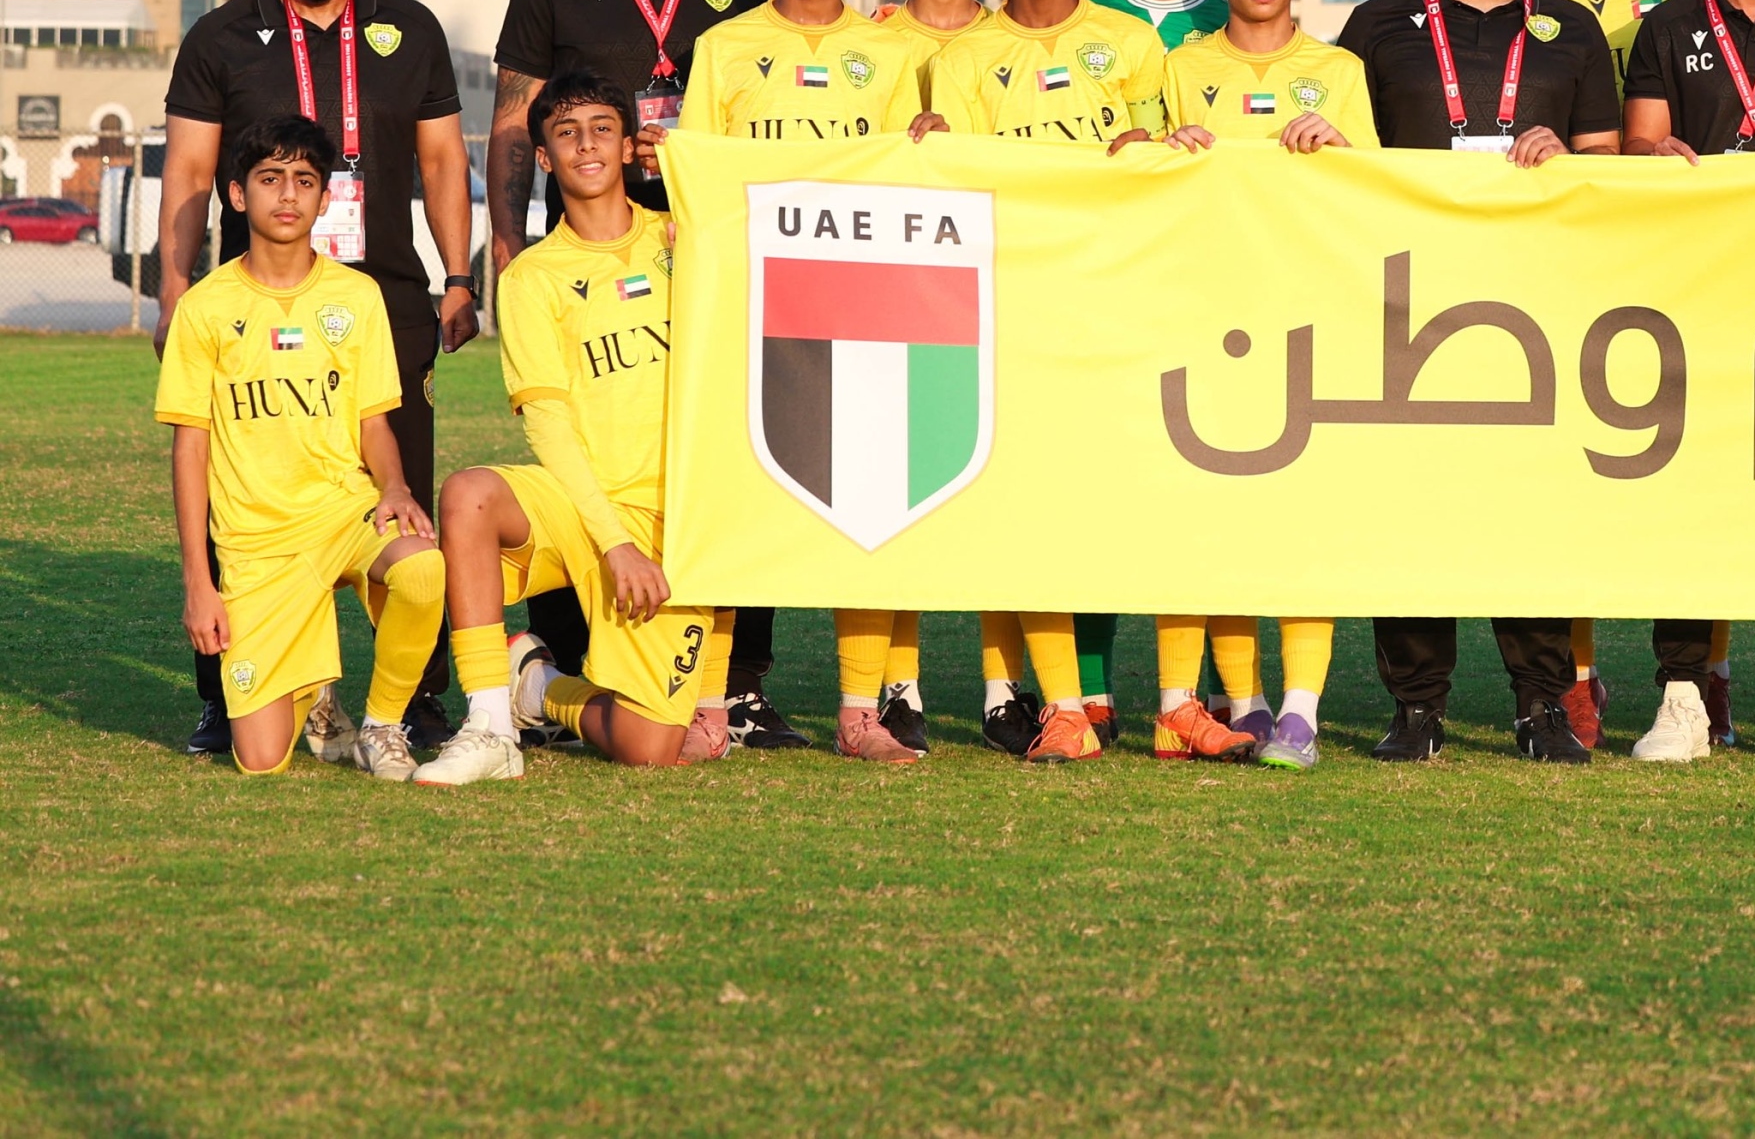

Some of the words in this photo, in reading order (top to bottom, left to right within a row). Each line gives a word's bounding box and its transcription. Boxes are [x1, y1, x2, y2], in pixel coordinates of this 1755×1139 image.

[1685, 52, 1714, 73] RC
[778, 206, 872, 240] UAE
[904, 213, 962, 245] FA
[581, 320, 670, 379] HUN
[1160, 250, 1687, 478] وطن
[228, 378, 334, 420] HUNA
[674, 624, 703, 674] 3
